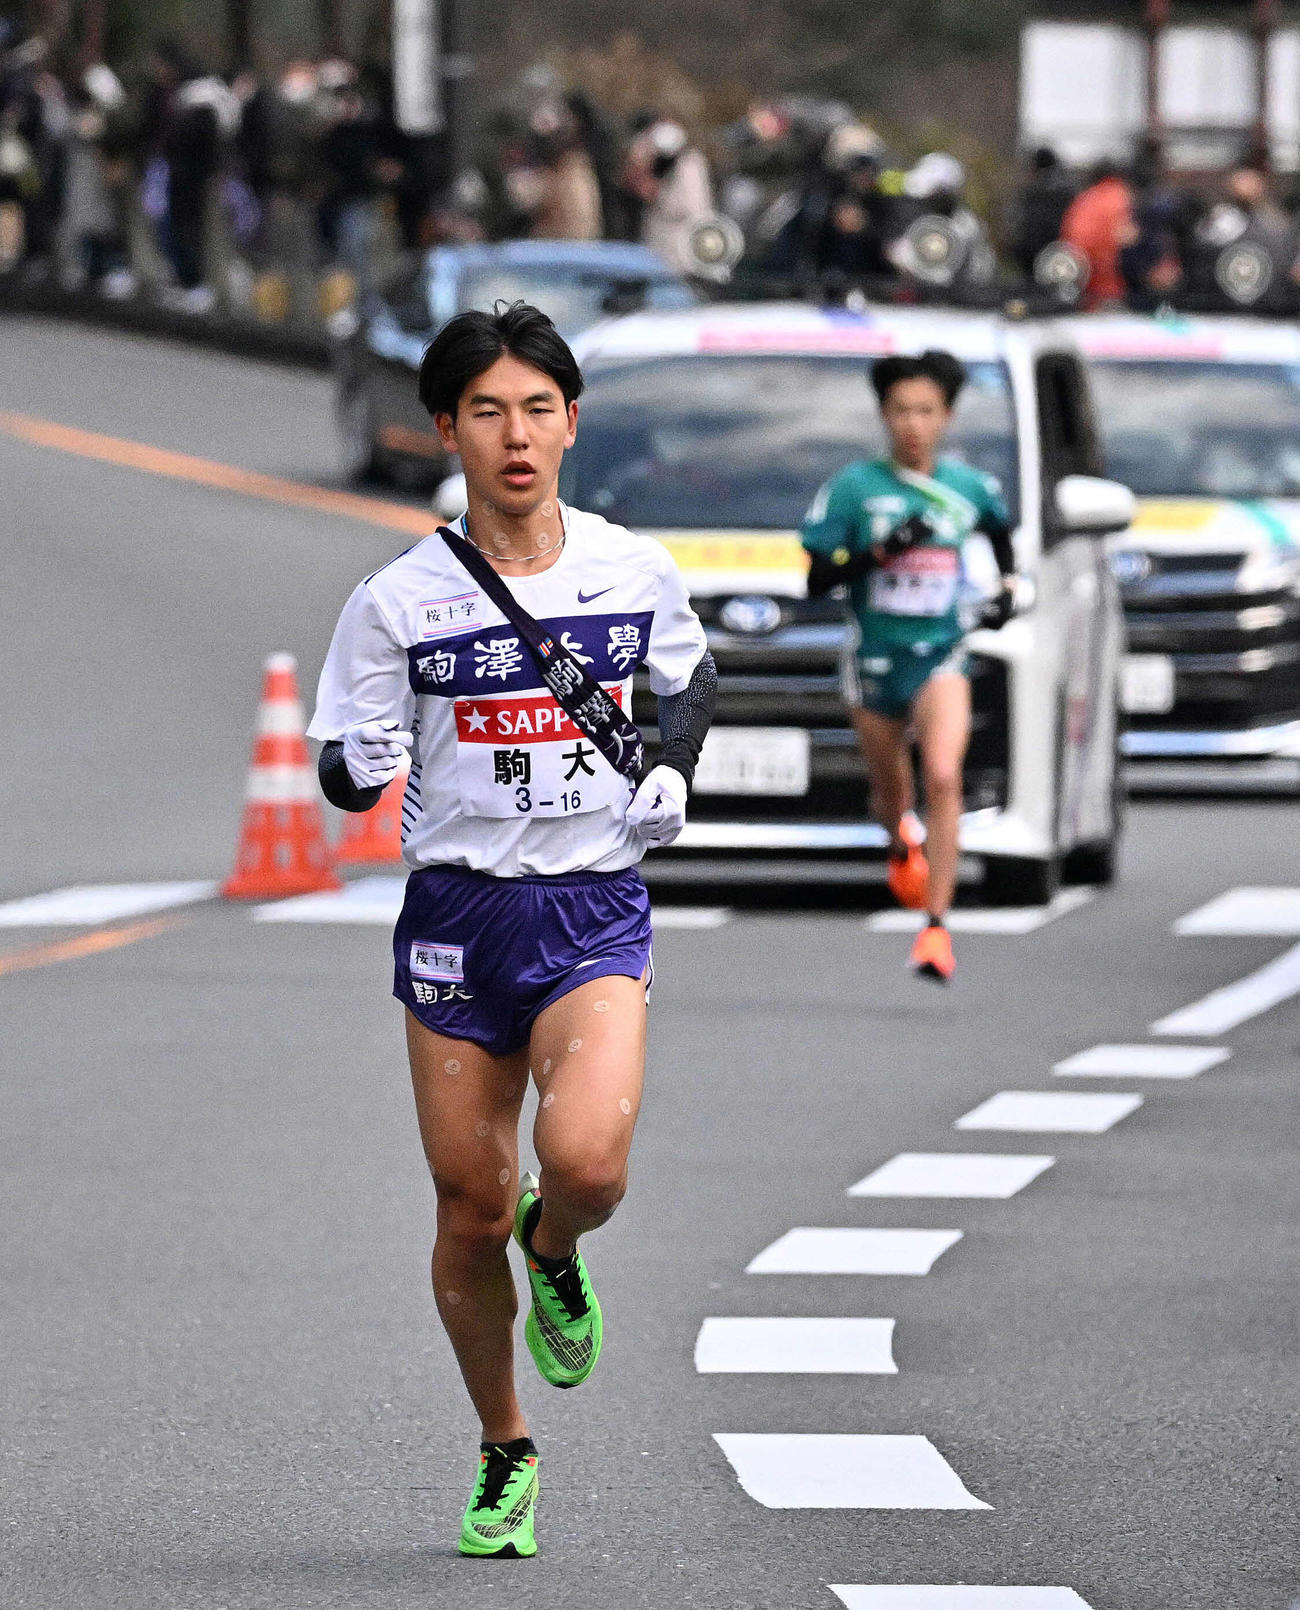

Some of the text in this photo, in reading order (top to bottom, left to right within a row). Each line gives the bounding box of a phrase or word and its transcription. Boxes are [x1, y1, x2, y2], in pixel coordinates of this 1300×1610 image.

[425, 601, 476, 623] 桜十字
[496, 698, 617, 736] SAPP
[493, 741, 596, 786] 駒大
[415, 949, 458, 968] 桜十字
[411, 981, 474, 1005] 駒大
